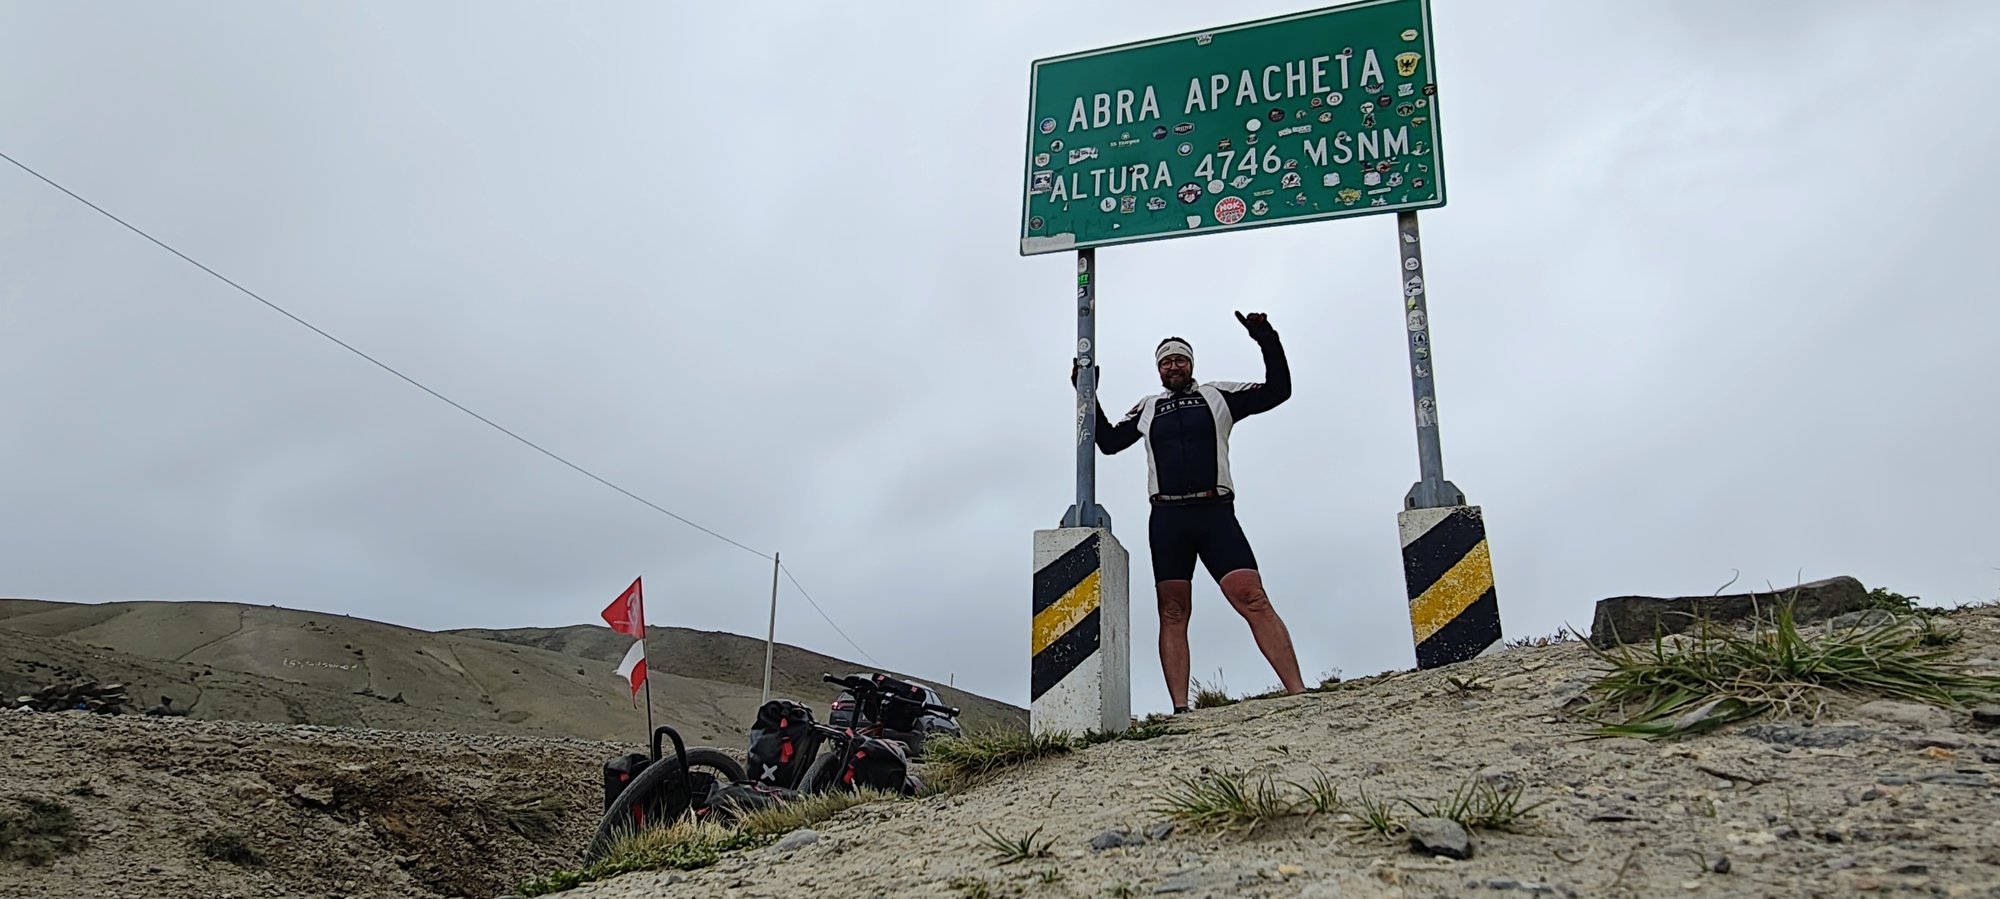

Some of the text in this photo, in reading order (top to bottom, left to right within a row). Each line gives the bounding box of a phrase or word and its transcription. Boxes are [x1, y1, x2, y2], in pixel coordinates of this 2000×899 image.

[1068, 48, 1385, 133] ABRA APACHETA
[1049, 126, 1409, 203] ALTURA 4746 MSNM
[1220, 201, 1240, 212] NGK
[1160, 399, 1200, 413] PRIMAL
